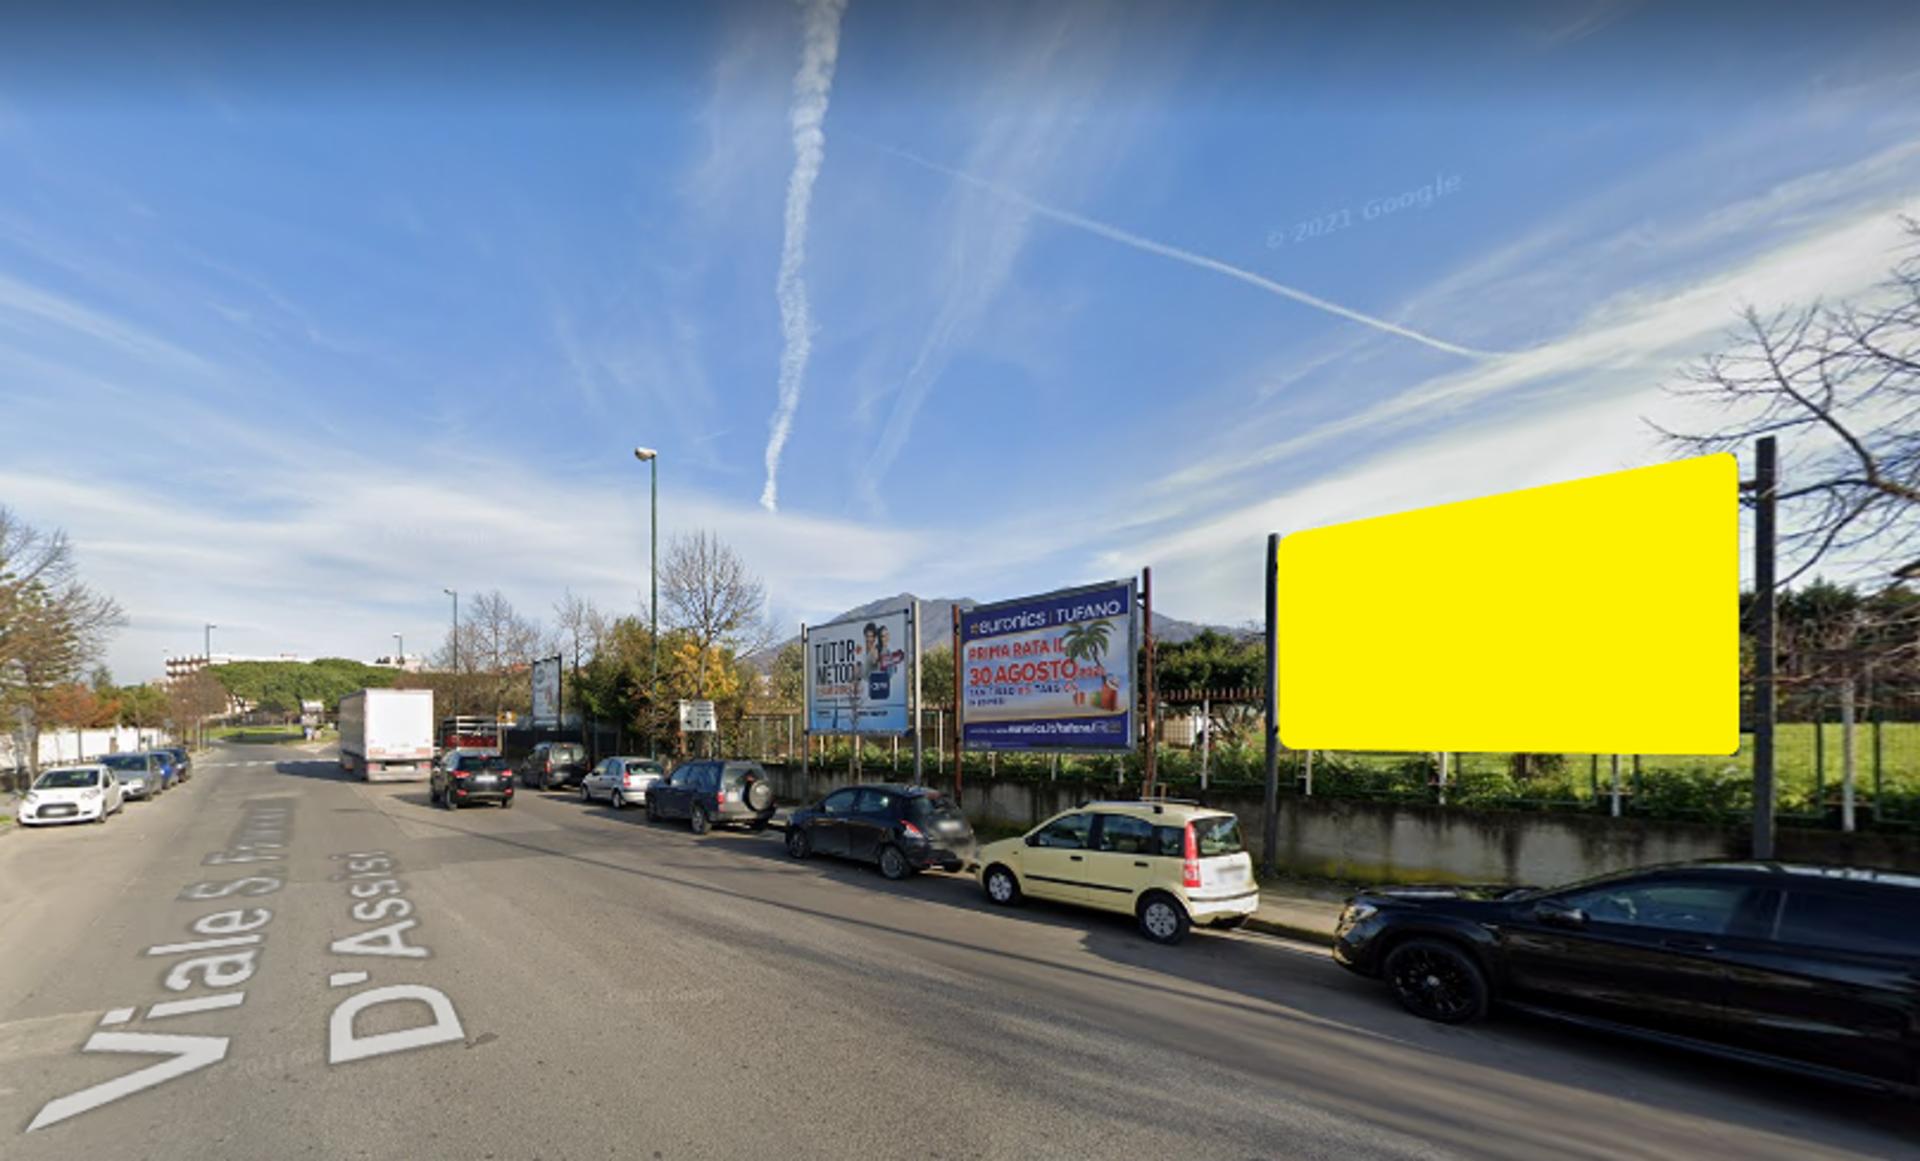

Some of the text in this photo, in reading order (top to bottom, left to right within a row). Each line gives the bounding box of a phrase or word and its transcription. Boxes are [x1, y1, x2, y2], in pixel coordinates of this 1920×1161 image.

[979, 600, 1121, 635] euronics TUFANO
[968, 643, 1010, 661] PRIMA
[1013, 639, 1049, 659] RATA
[969, 665, 993, 686] 30
[994, 658, 1079, 684] AGOSTO
